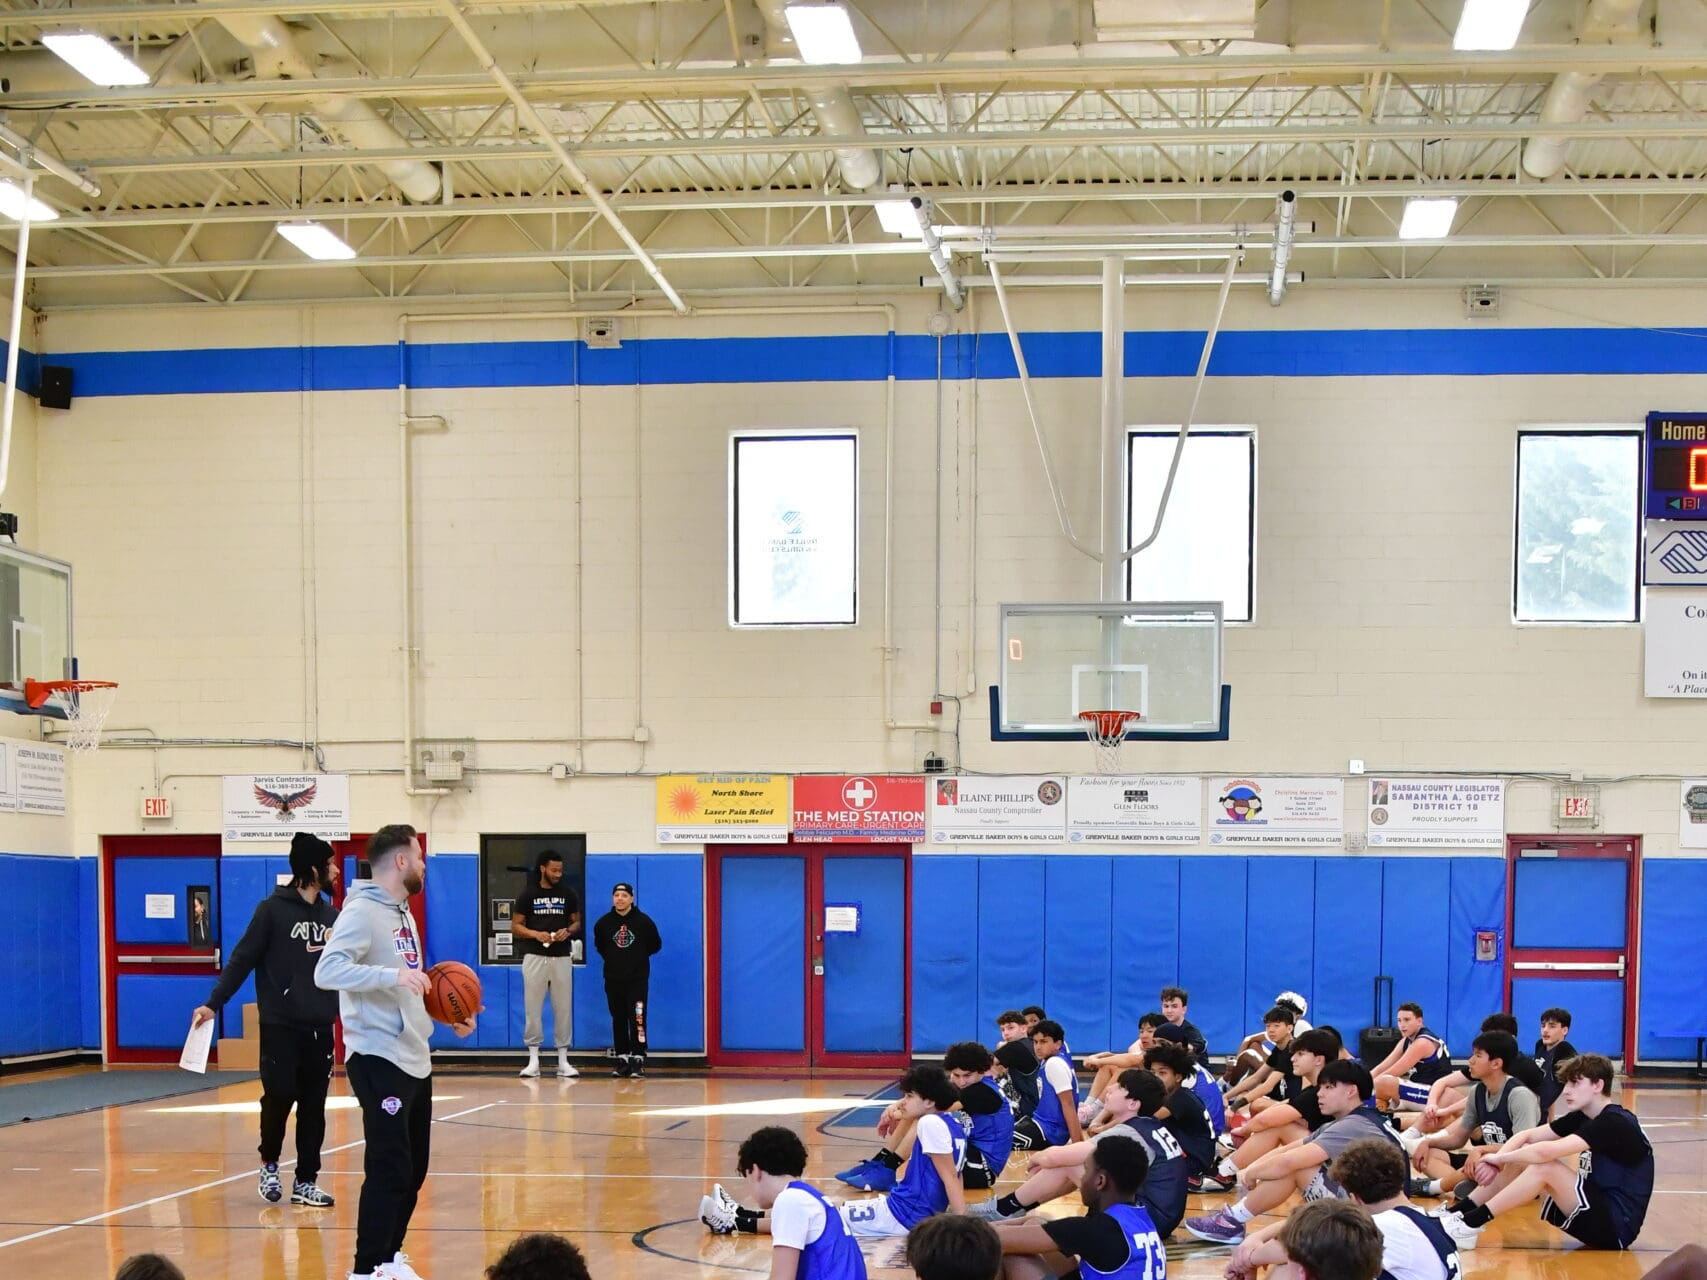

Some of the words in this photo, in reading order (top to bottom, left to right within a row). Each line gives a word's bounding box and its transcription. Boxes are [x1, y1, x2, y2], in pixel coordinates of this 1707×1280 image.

[1662, 421, 1706, 440] Home
[1685, 605, 1707, 618] Co
[1682, 670, 1698, 680] On
[1079, 778, 1108, 786] Fashion
[1109, 778, 1119, 786] for
[1121, 778, 1138, 786] your
[1138, 778, 1158, 786] floors
[960, 794, 992, 803] ELAINE
[994, 794, 1034, 803] PHILLIPS
[1391, 793, 1449, 801] SAMANTHA
[1452, 793, 1462, 801] A.
[1465, 793, 1500, 801] GOETZ
[145, 798, 167, 816] EXIT
[954, 807, 978, 815] Nassau
[979, 807, 1002, 815] County
[1003, 807, 1042, 815] Comptroller
[795, 811, 823, 822] THE
[827, 811, 860, 822] MED
[863, 811, 925, 822] STATION
[447, 990, 465, 1019] ilson
